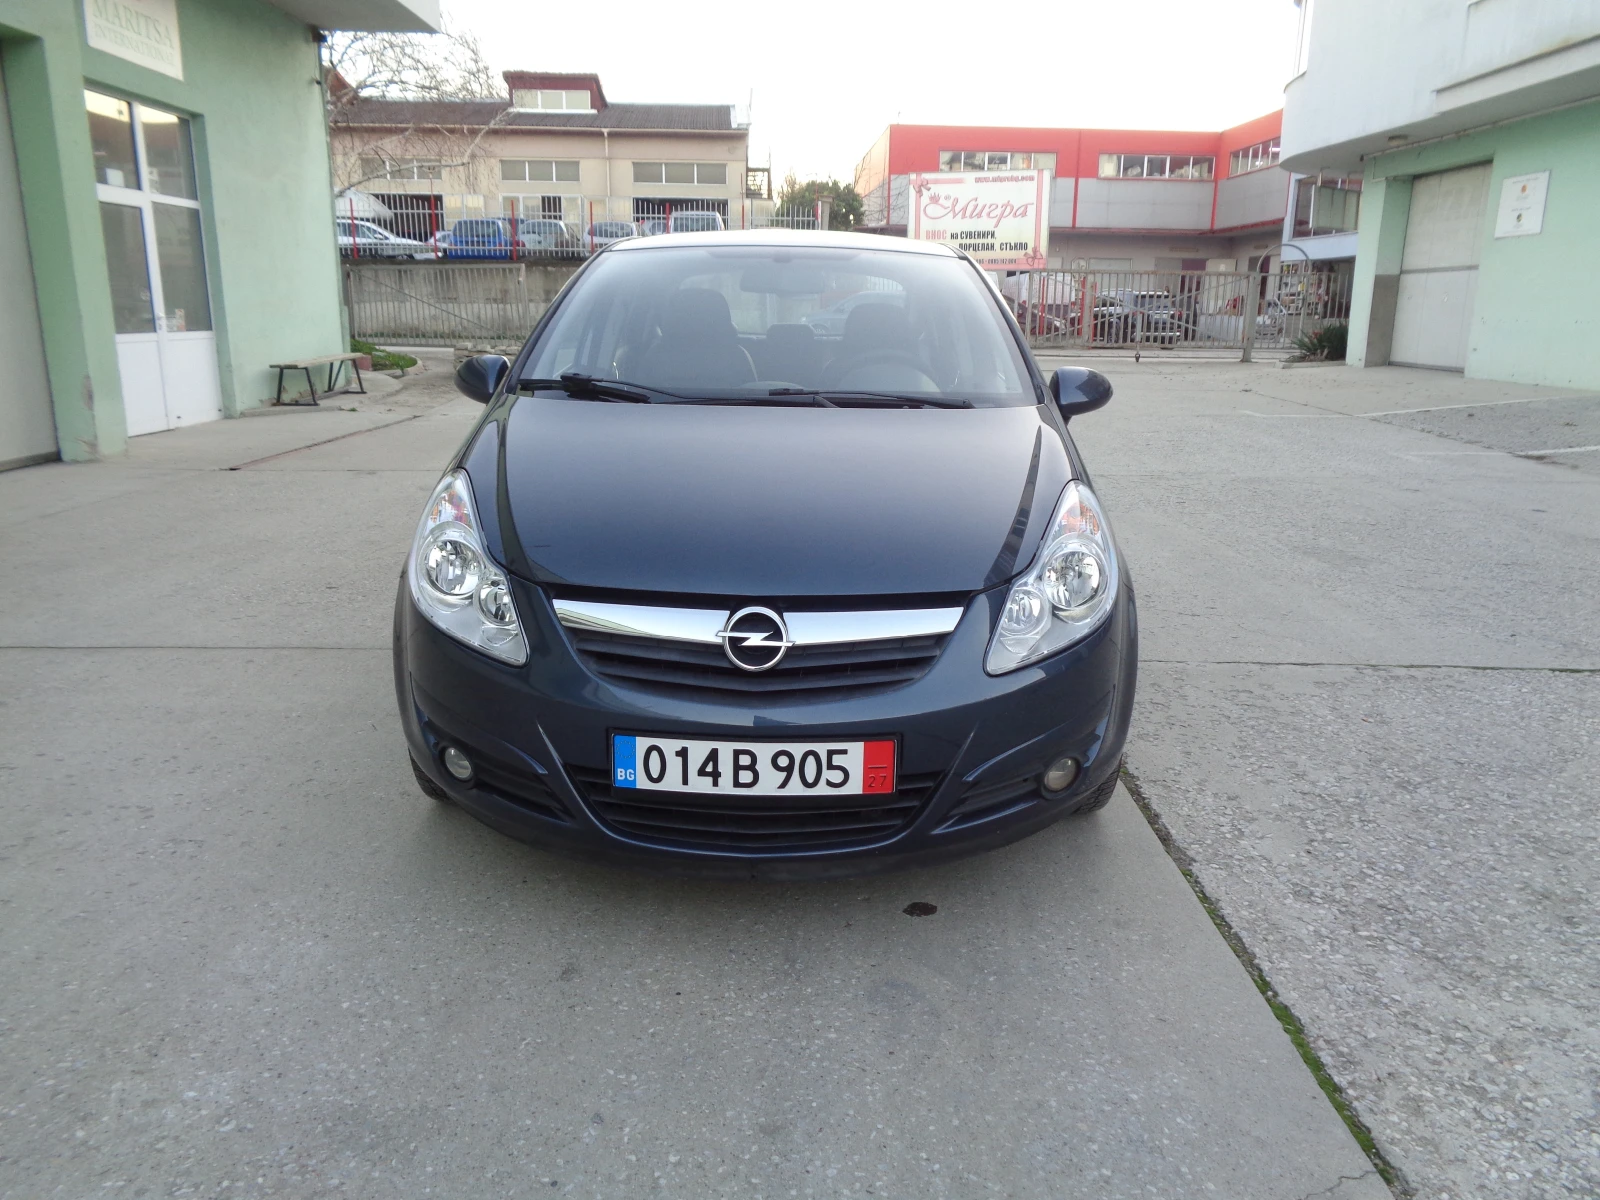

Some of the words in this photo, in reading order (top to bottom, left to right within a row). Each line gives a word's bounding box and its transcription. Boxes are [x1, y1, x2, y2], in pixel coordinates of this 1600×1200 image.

[92, 0, 175, 50] MARITSA
[923, 197, 1034, 228] Мигра
[925, 229, 947, 240] ВНОС
[950, 232, 959, 240] на
[960, 230, 997, 240] СУВЕНИРИ,
[999, 242, 1028, 251] СТЪКЛО
[617, 768, 635, 781] BG
[867, 774, 887, 788] 27
